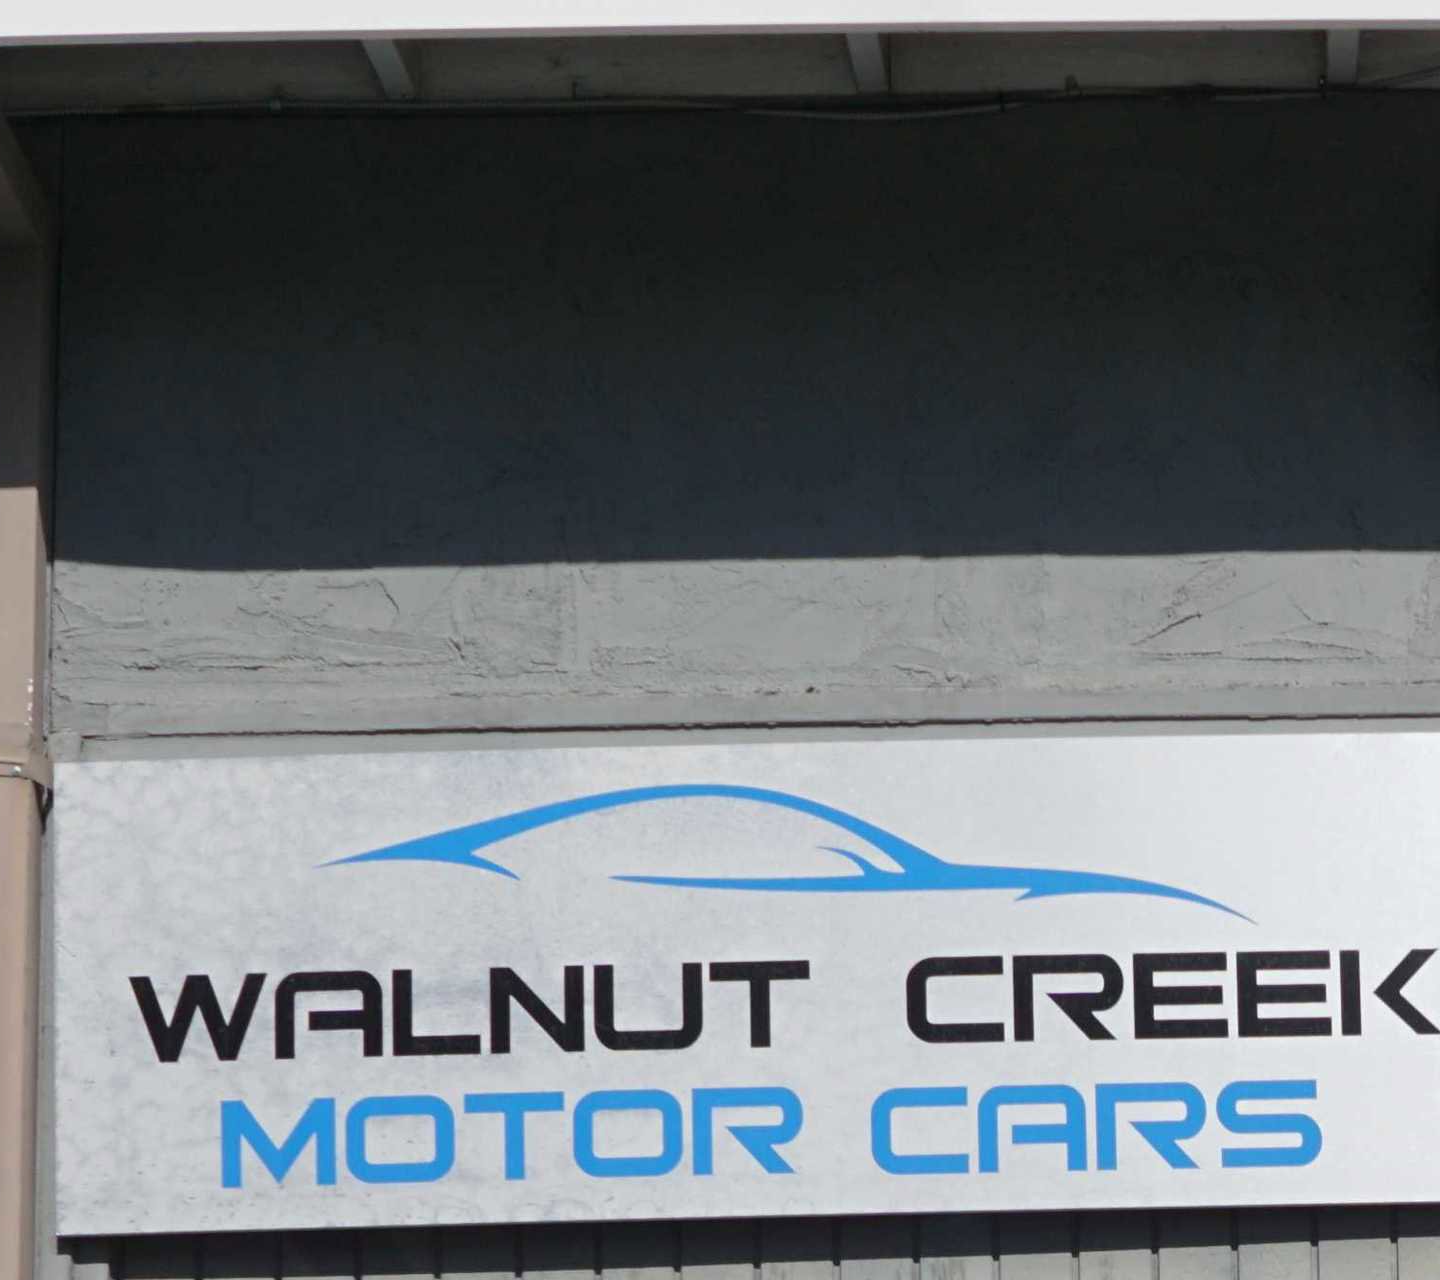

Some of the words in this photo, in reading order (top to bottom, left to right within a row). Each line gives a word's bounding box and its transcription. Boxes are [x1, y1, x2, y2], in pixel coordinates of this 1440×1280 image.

[129, 960, 810, 1062] WALNUT
[220, 1086, 805, 1189] MOTOR
[870, 1078, 1324, 1176] CARS
